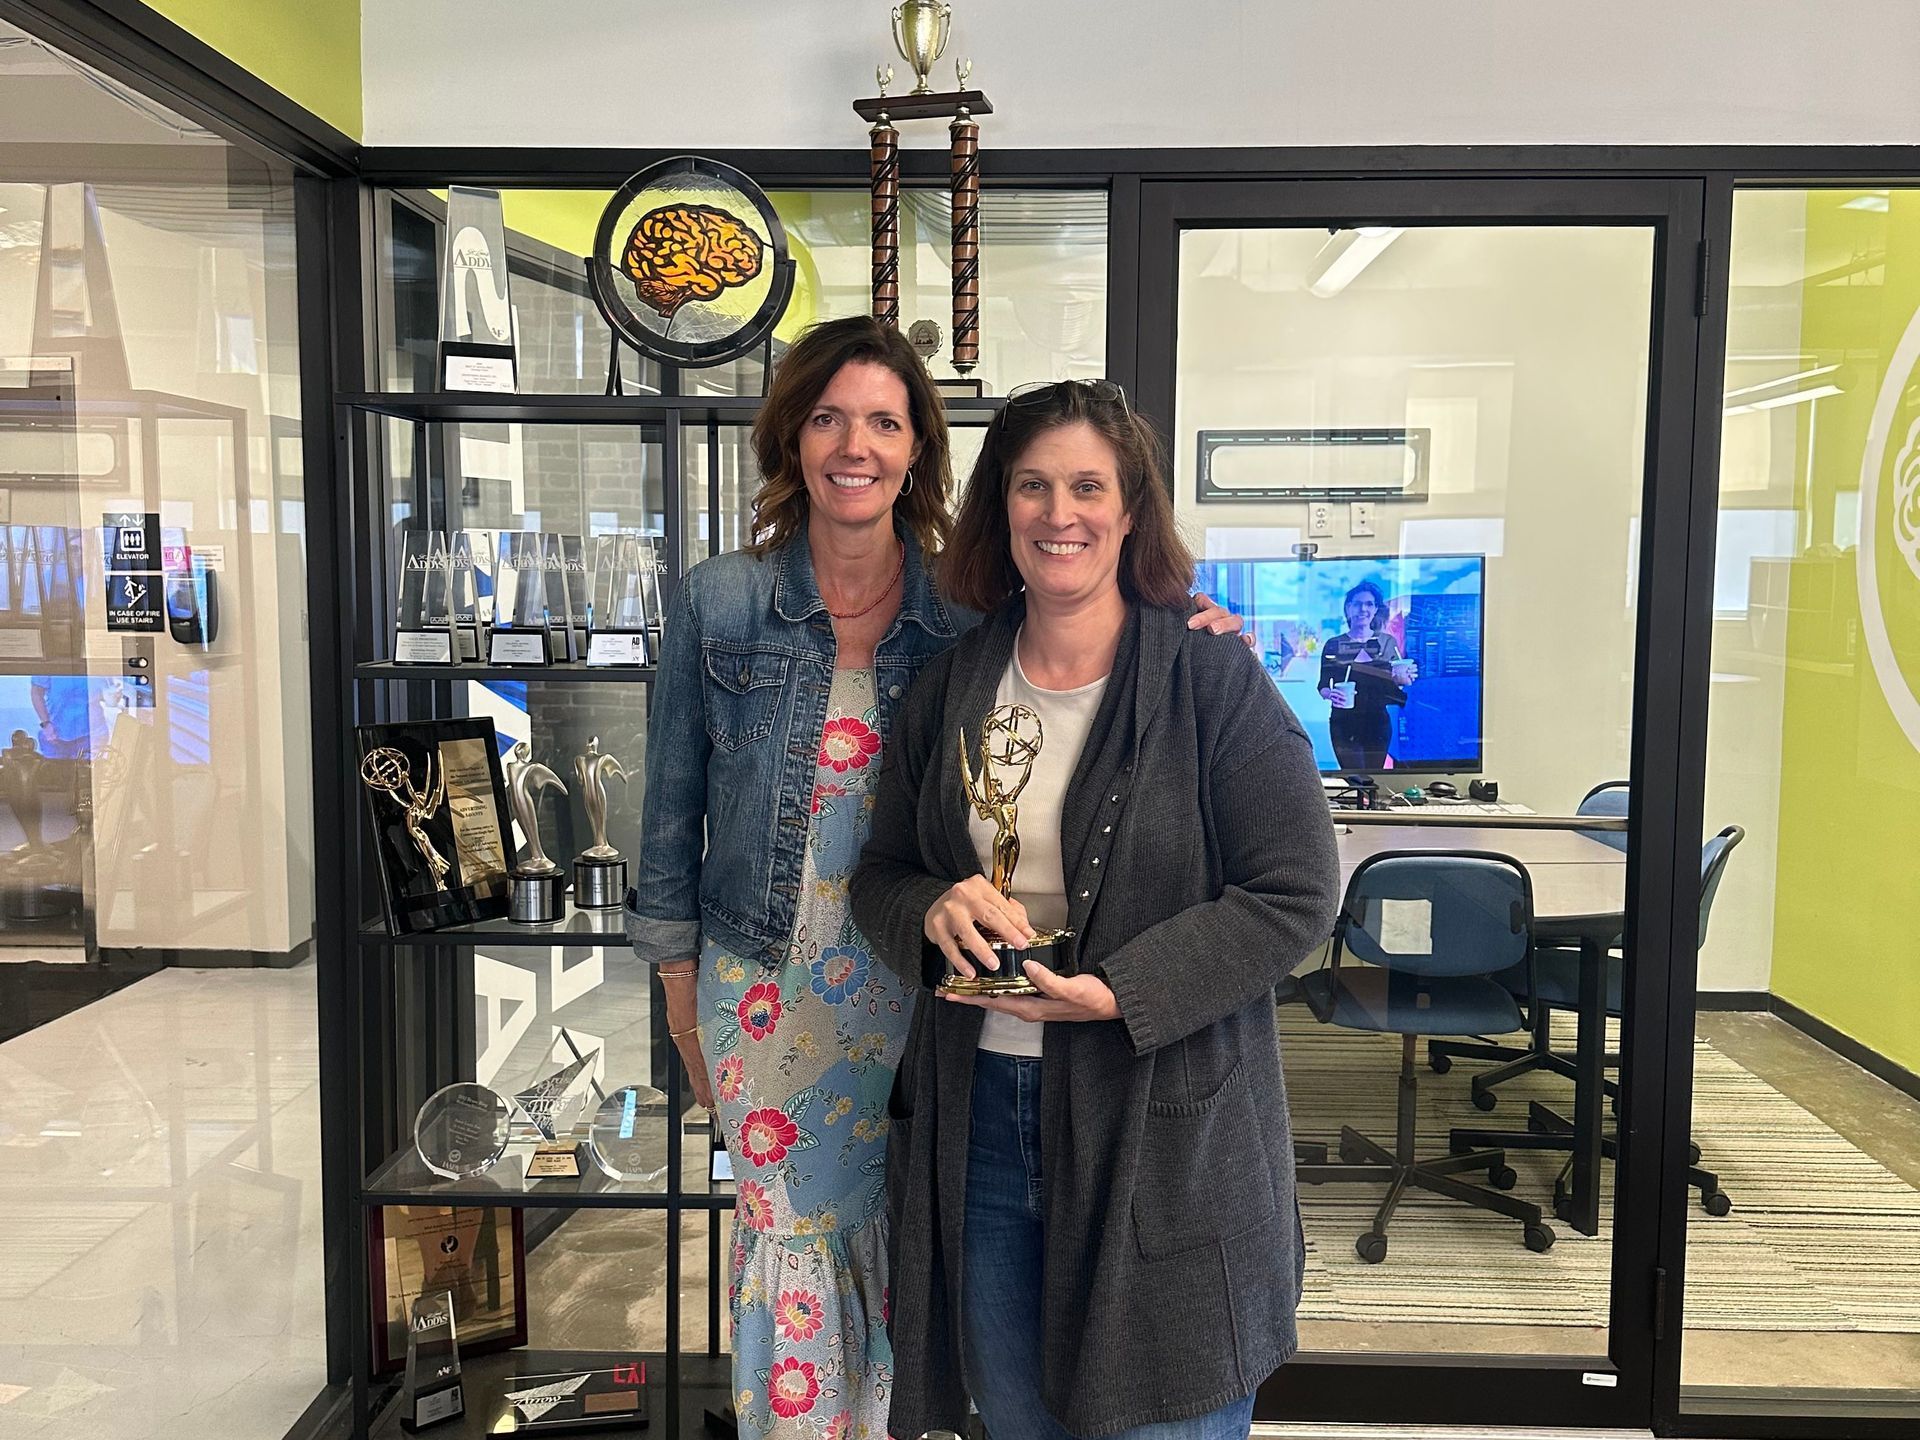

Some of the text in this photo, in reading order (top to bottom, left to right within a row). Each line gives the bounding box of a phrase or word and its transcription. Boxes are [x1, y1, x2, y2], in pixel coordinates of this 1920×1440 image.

[116, 553, 149, 561] ELEVATOR
[116, 616, 154, 624] USE STAIRS
